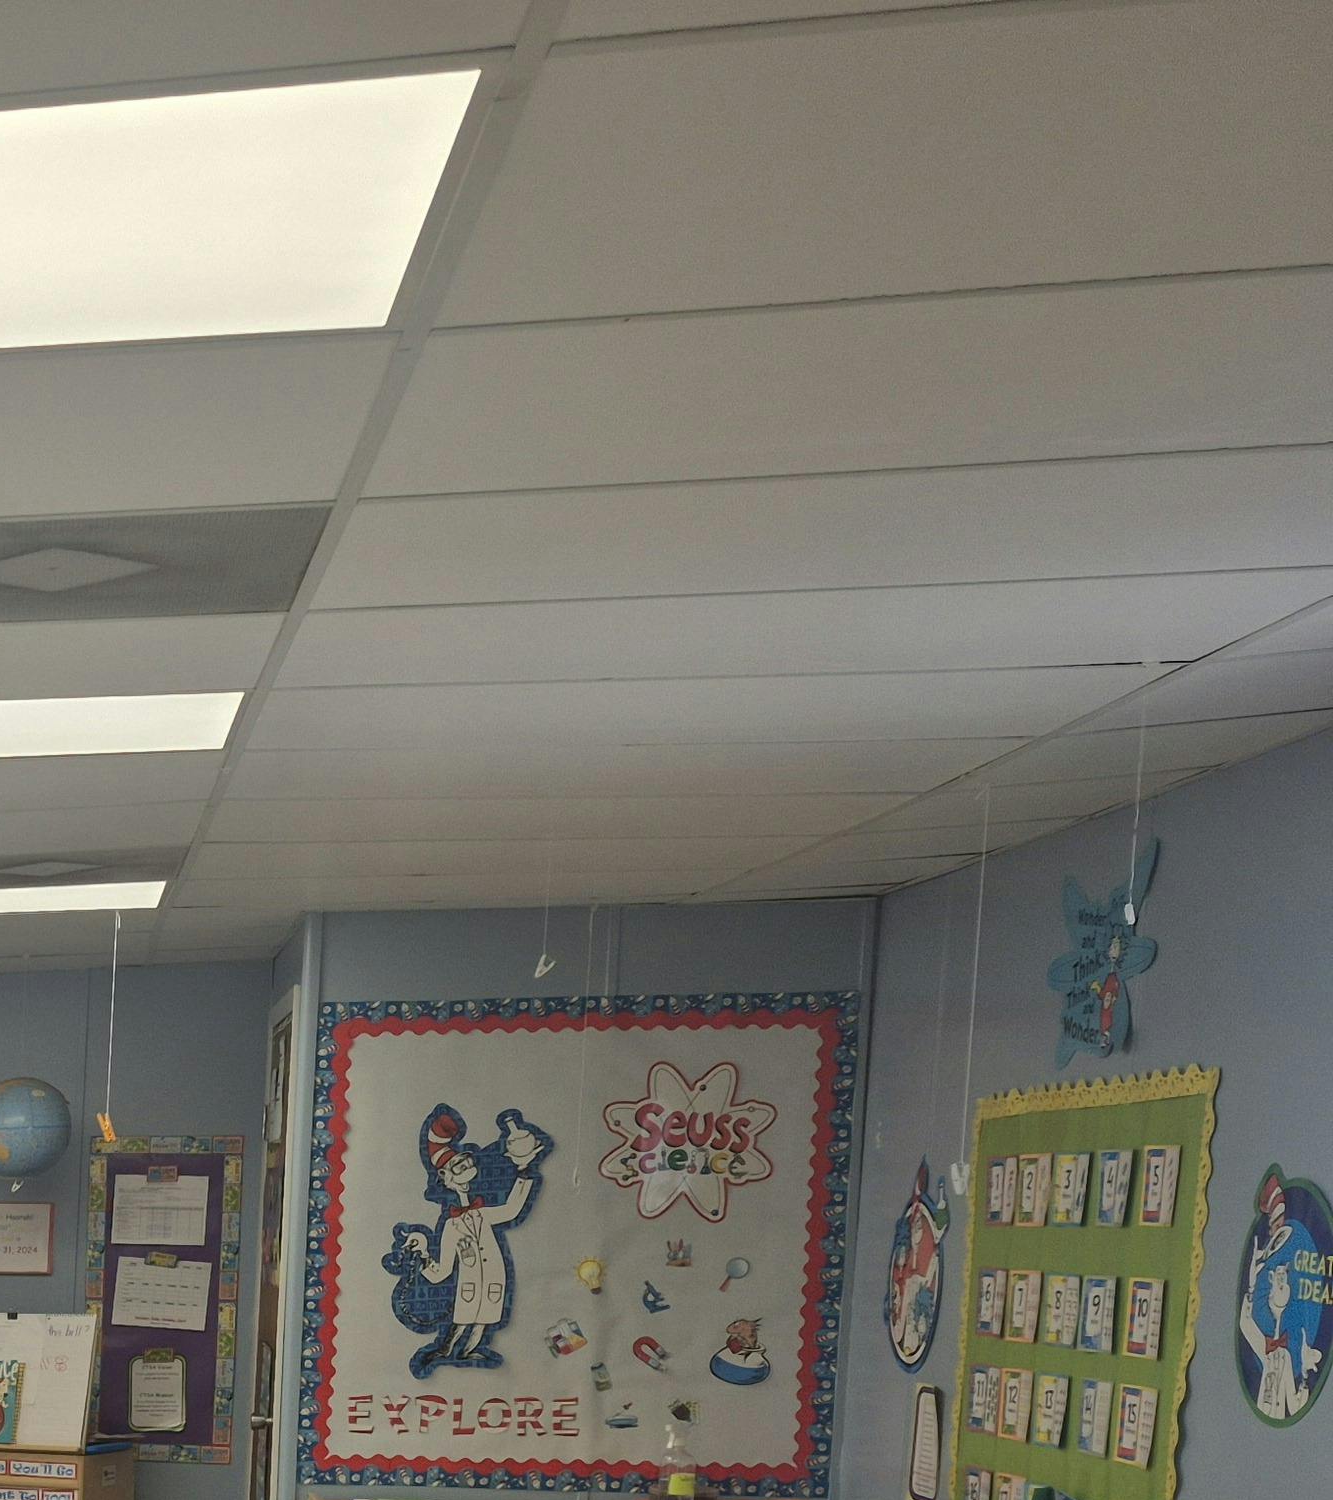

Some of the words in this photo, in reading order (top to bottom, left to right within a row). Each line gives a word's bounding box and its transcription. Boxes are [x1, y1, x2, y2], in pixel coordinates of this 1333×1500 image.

[634, 1103, 752, 1153] Seuss
[1026, 1172, 1033, 1190] 2
[1065, 1170, 1073, 1188] 3
[1106, 1167, 1114, 1188] 4
[1153, 1165, 1160, 1186] 5
[17, 1246, 38, 1254] 2024
[1294, 1249, 1333, 1277] GREAT
[1018, 1288, 1024, 1306] 7
[1055, 1290, 1063, 1309] 8
[1093, 1295, 1101, 1315] 9
[1137, 1298, 1149, 1318] 10
[1045, 1390, 1055, 1409] 13
[347, 1394, 580, 1436] EXPLORE
[1127, 1403, 1137, 1424] 15
[57, 1465, 74, 1476] Go
